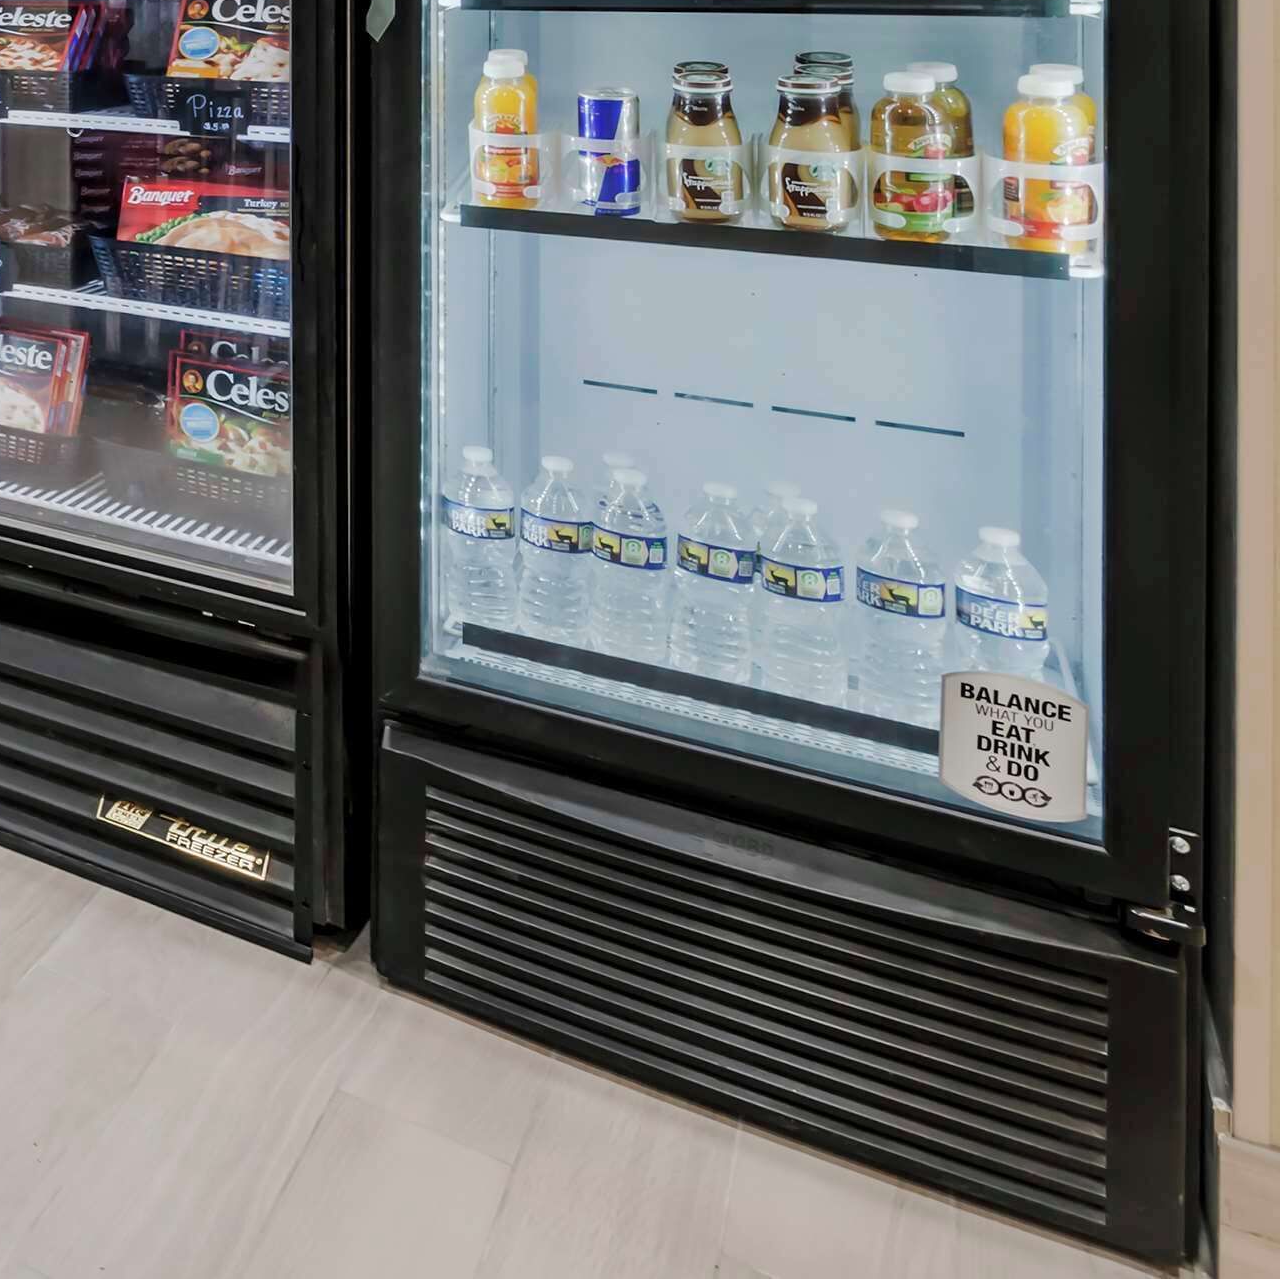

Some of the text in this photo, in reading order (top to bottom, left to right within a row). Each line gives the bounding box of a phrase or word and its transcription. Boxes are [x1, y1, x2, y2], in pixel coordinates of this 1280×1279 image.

[186, 94, 244, 119] Pizza
[127, 185, 195, 206] Banquet
[243, 198, 278, 209] Turkey
[206, 369, 289, 413] Celes
[970, 601, 1022, 624] DEER
[970, 614, 1024, 637] PARK
[960, 682, 1072, 722] BALANCE
[975, 703, 1054, 731] WHAT YOU
[976, 734, 1050, 768] DRINK
[985, 755, 1039, 782] & DO
[165, 832, 255, 871] FREEZER
